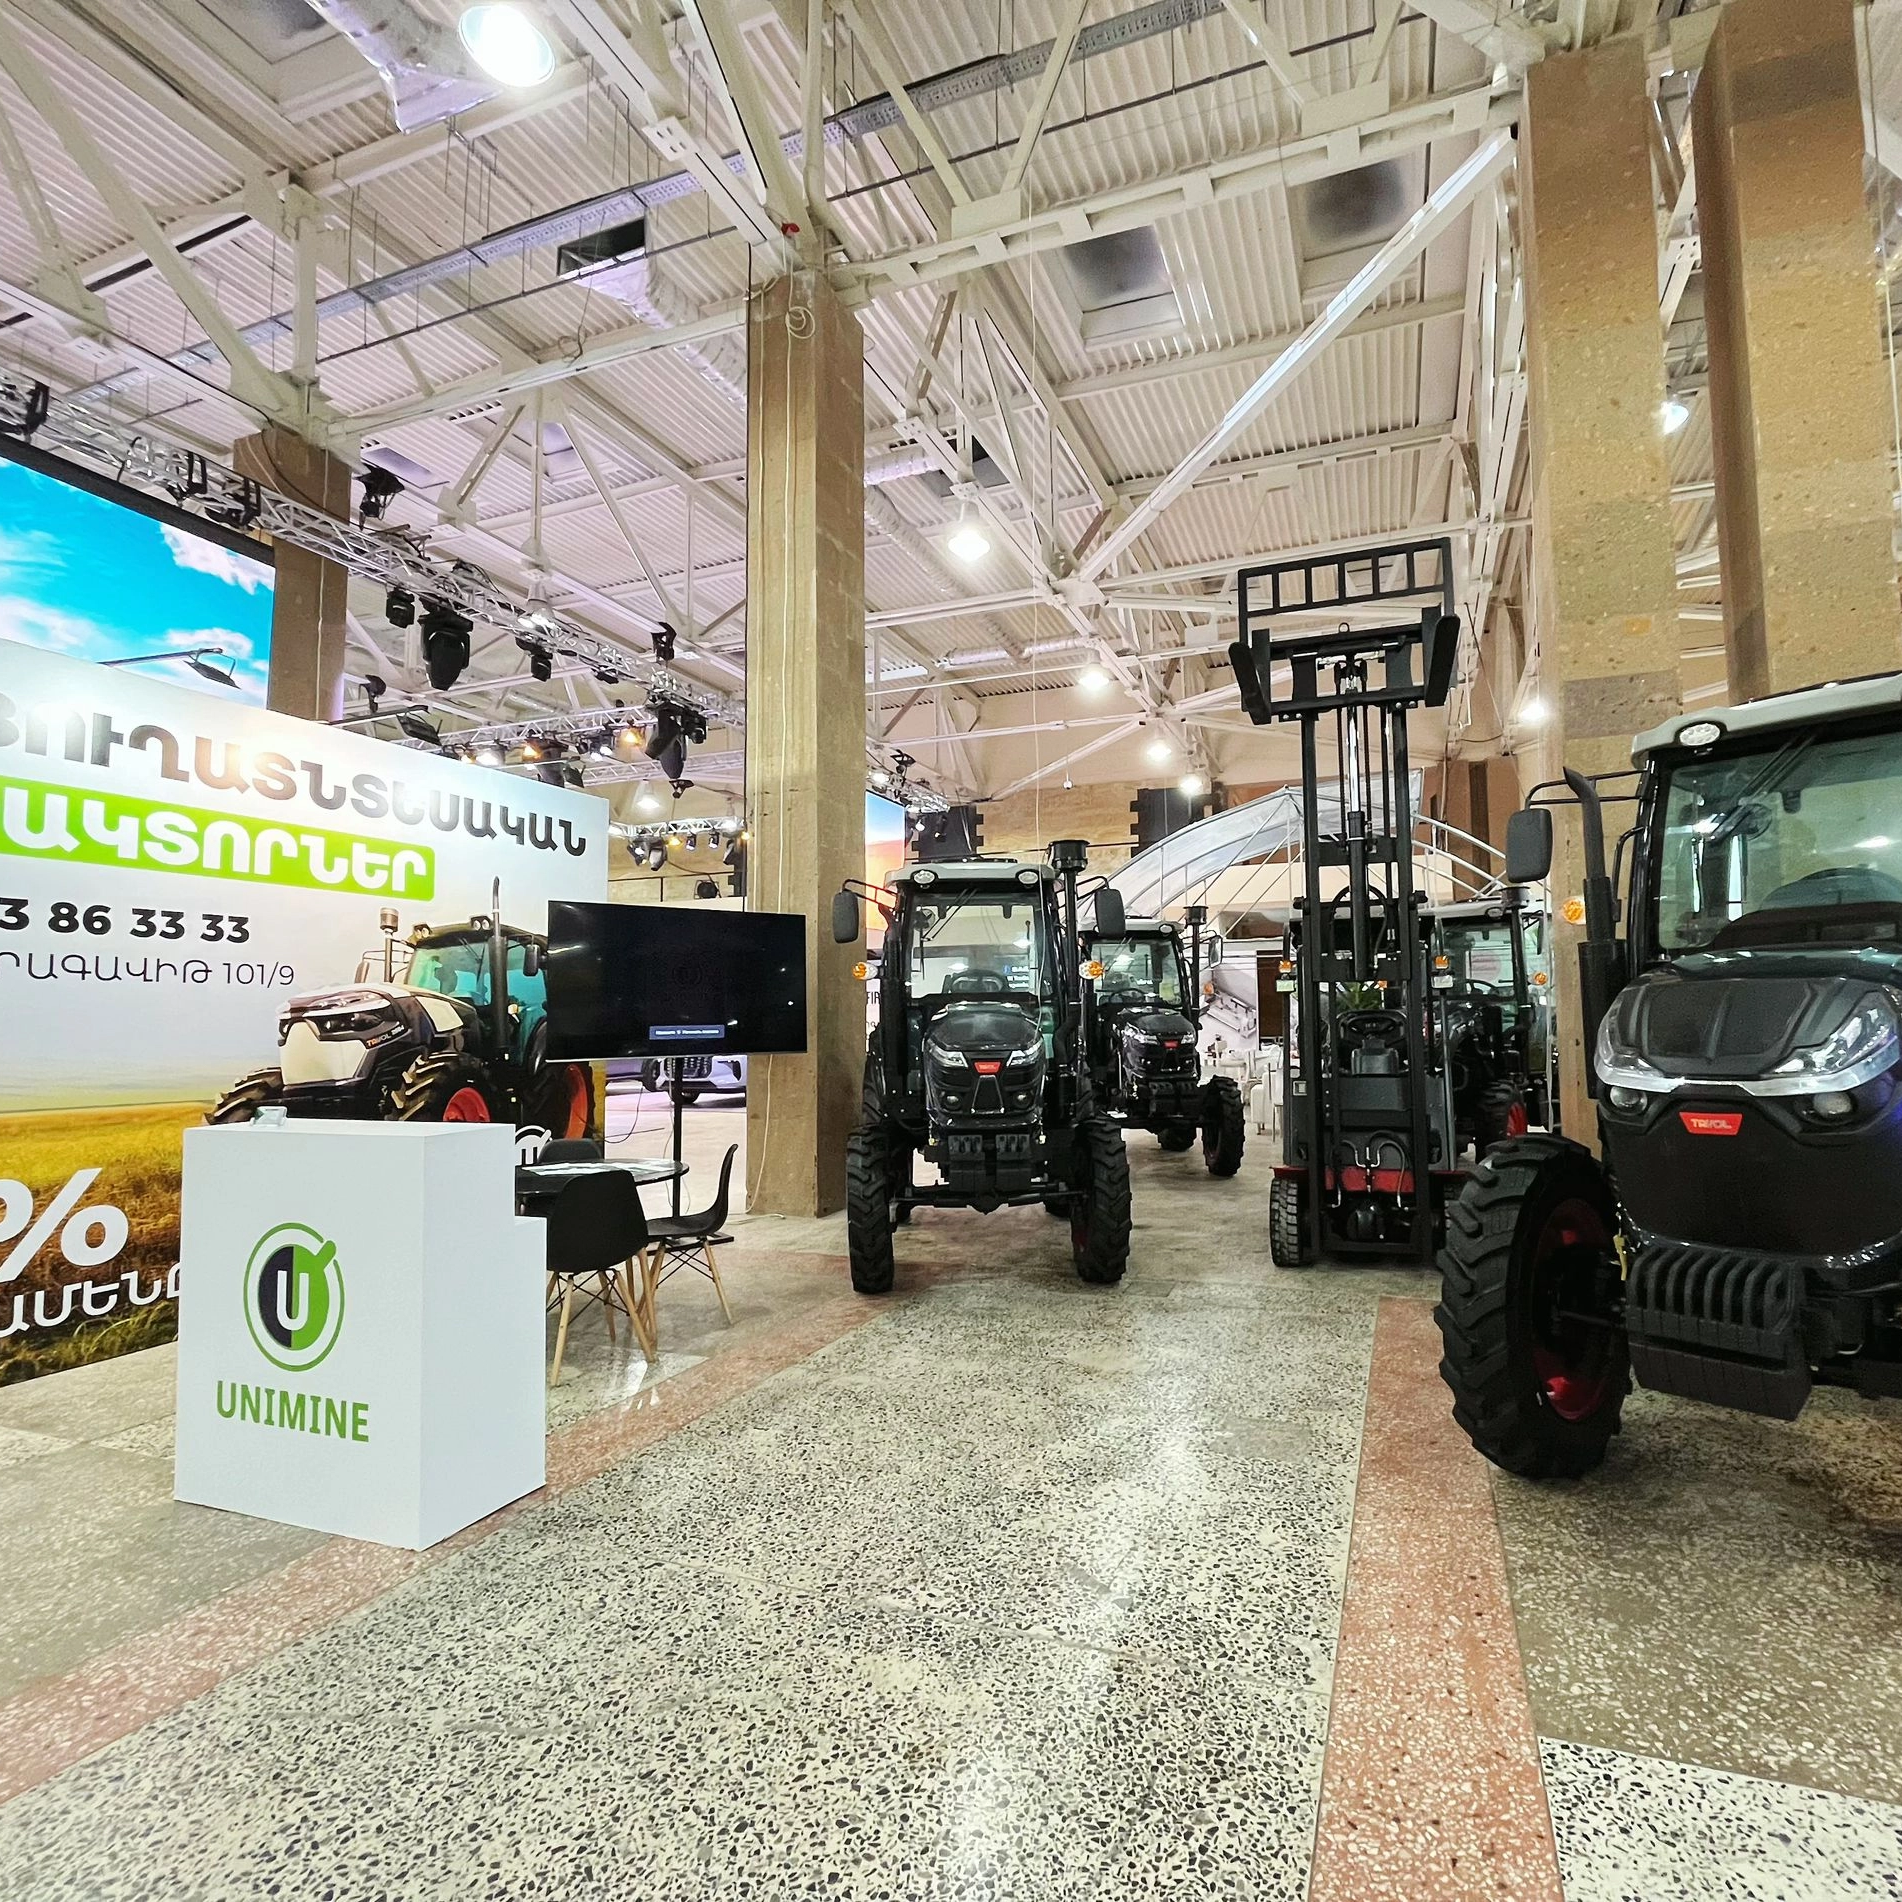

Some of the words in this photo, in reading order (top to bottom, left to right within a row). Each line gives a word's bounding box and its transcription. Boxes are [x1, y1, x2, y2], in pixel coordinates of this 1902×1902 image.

[48, 901, 112, 936] 86
[129, 907, 185, 940] 33
[200, 913, 250, 944] 33
[223, 961, 295, 989] 101/9
[276, 1270, 309, 1331] U
[216, 1380, 369, 1443] UNIMINE
